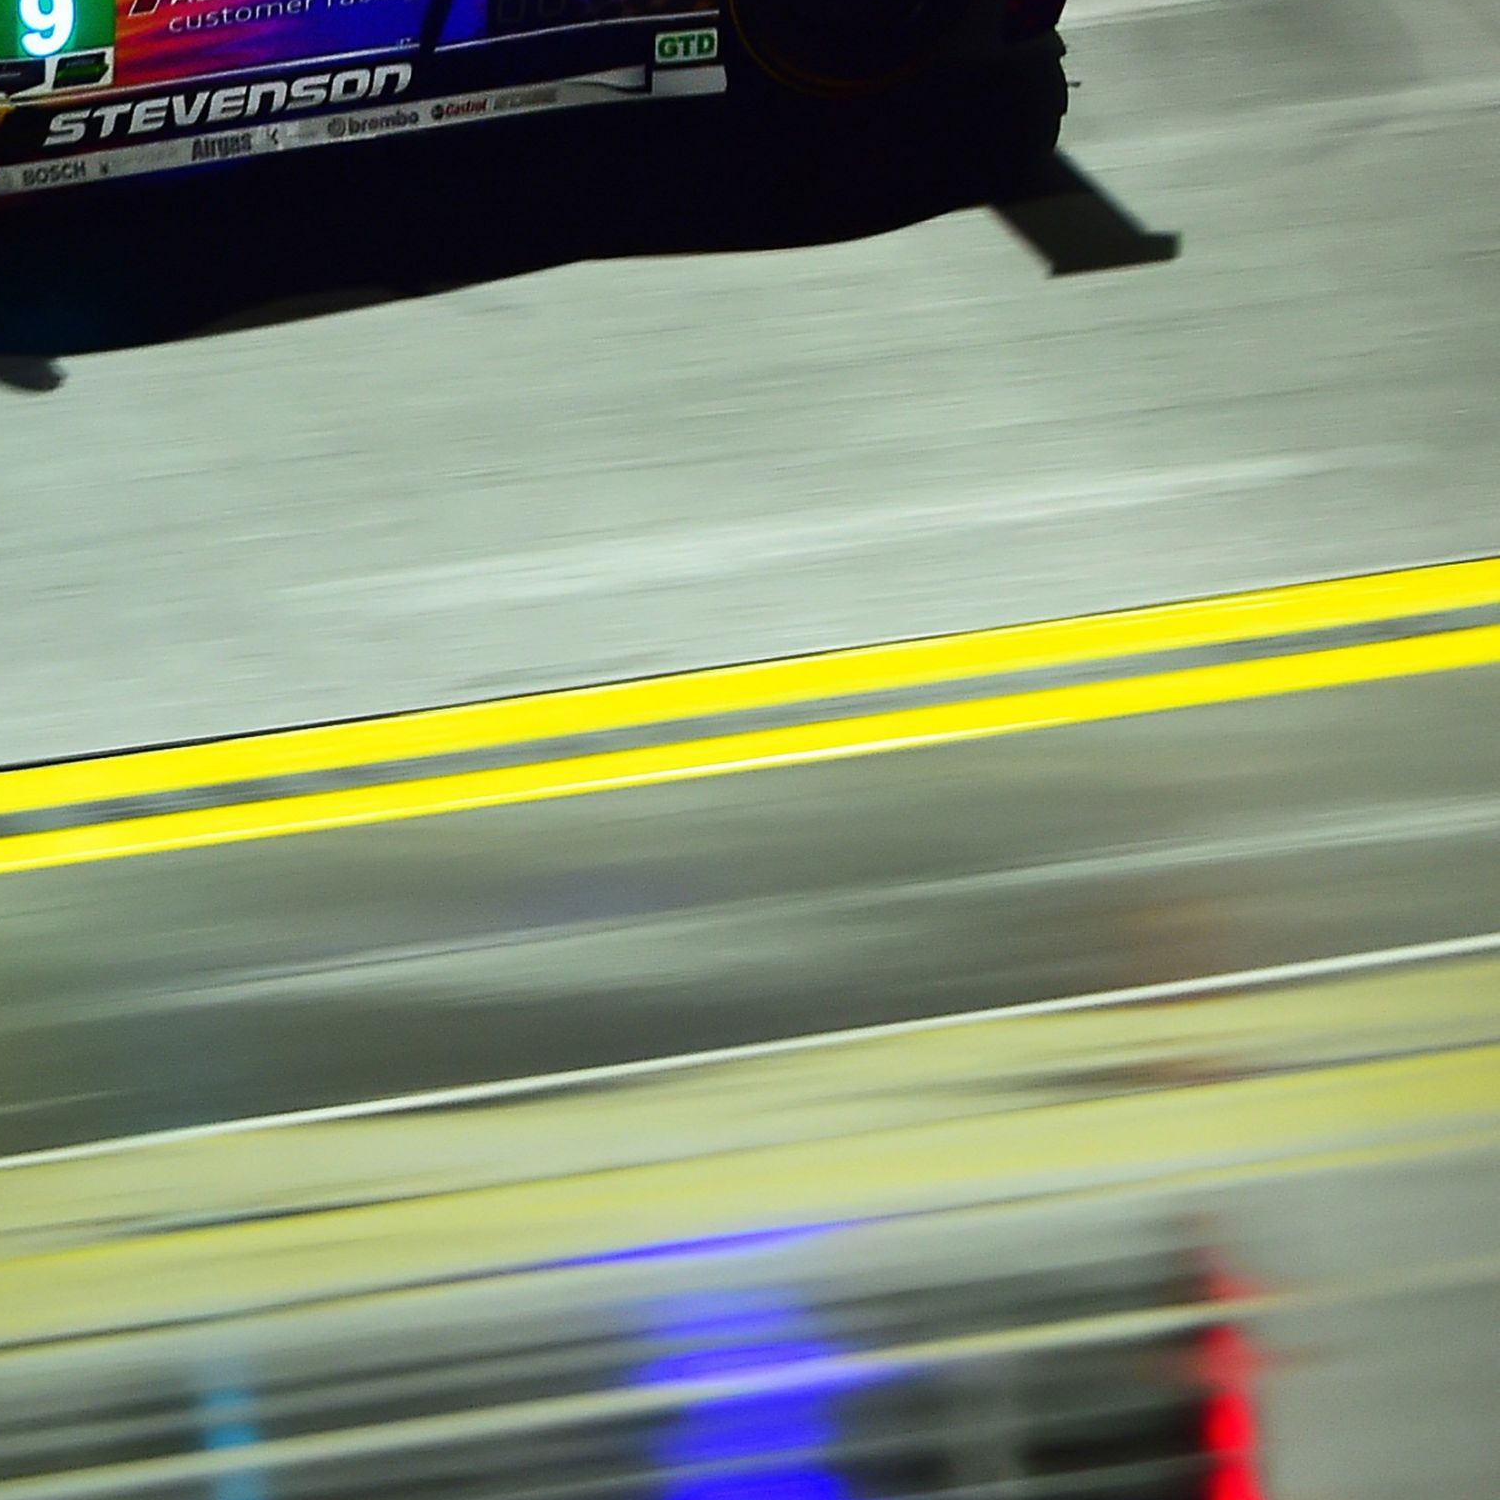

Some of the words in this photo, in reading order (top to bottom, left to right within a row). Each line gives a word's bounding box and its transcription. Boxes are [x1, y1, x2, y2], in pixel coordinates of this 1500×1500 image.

[657, 31, 717, 59] GTD
[43, 62, 412, 148] STEVENSON
[442, 99, 488, 116] Castrol
[347, 109, 420, 134] brembo
[21, 161, 88, 187] BOSCH
